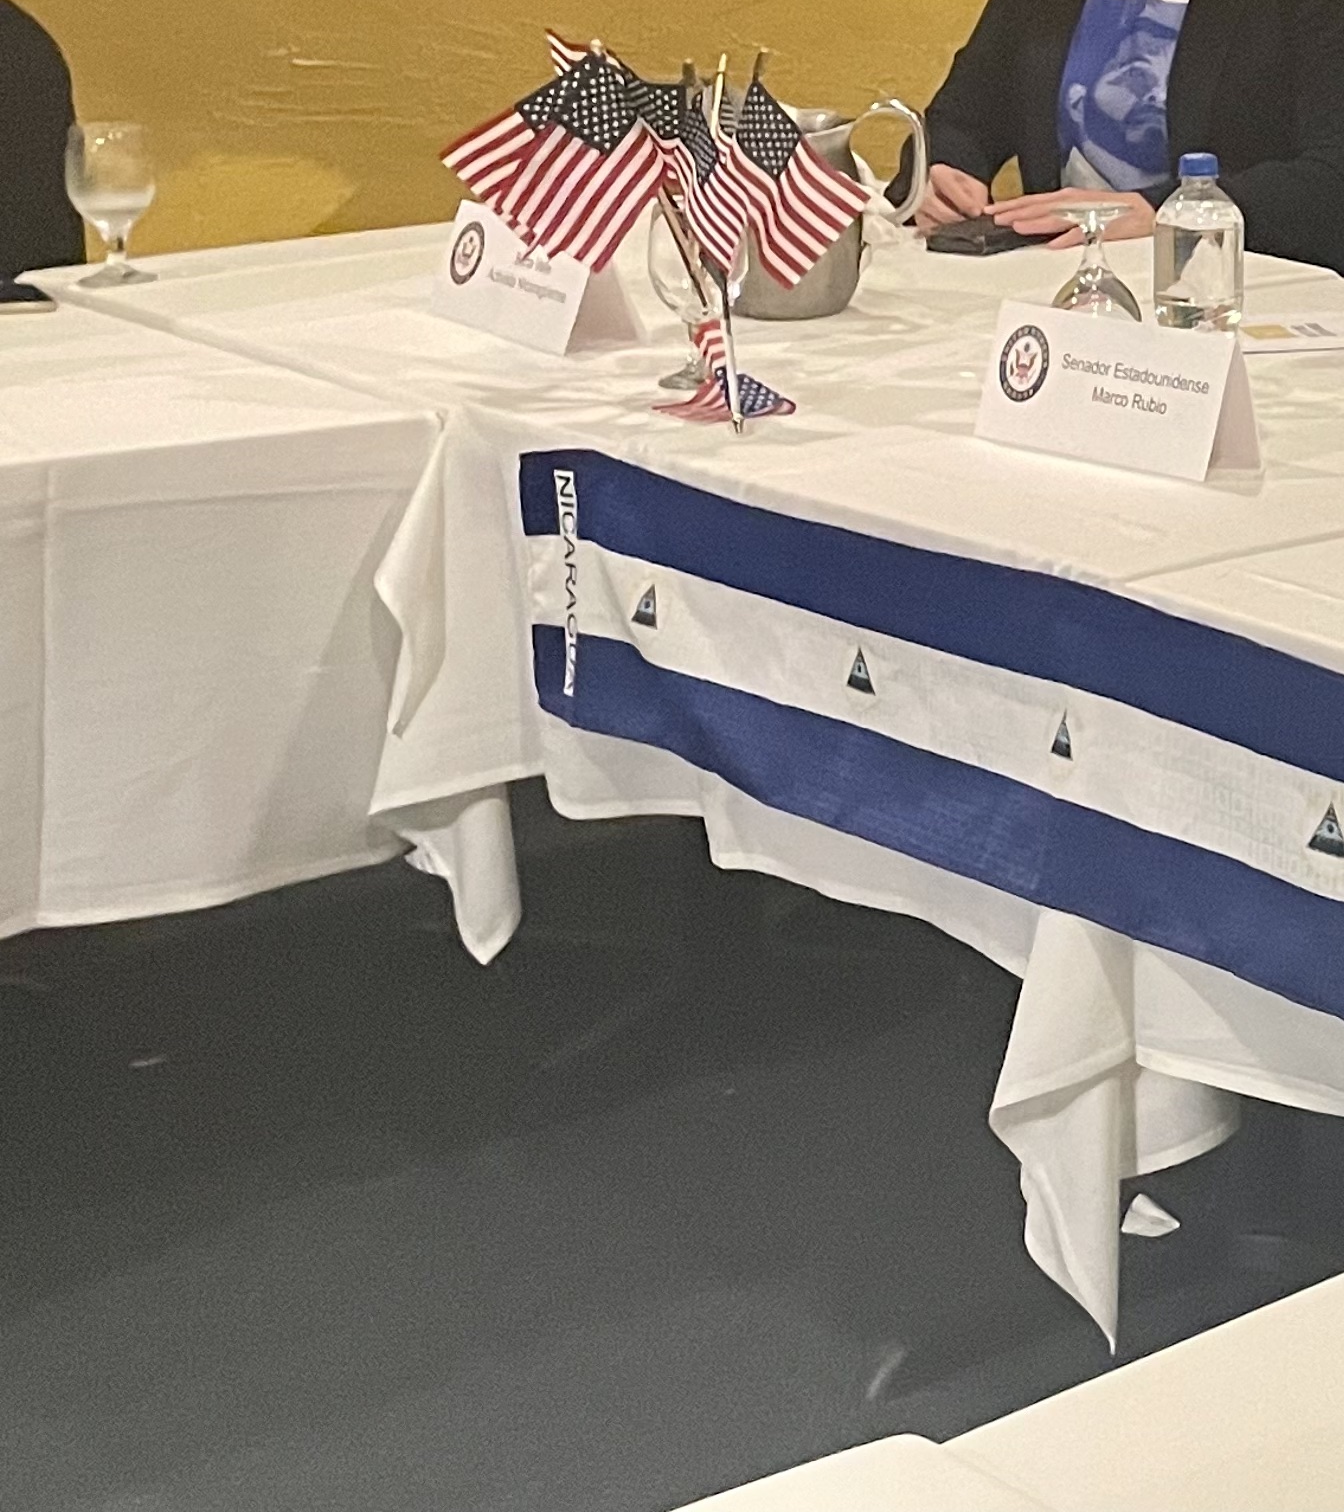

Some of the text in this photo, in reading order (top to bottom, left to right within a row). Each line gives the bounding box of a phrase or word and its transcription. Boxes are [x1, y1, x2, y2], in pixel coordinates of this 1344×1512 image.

[1062, 353, 1210, 394] Senador Estadounidense
[1092, 386, 1167, 415] Marco Rubio
